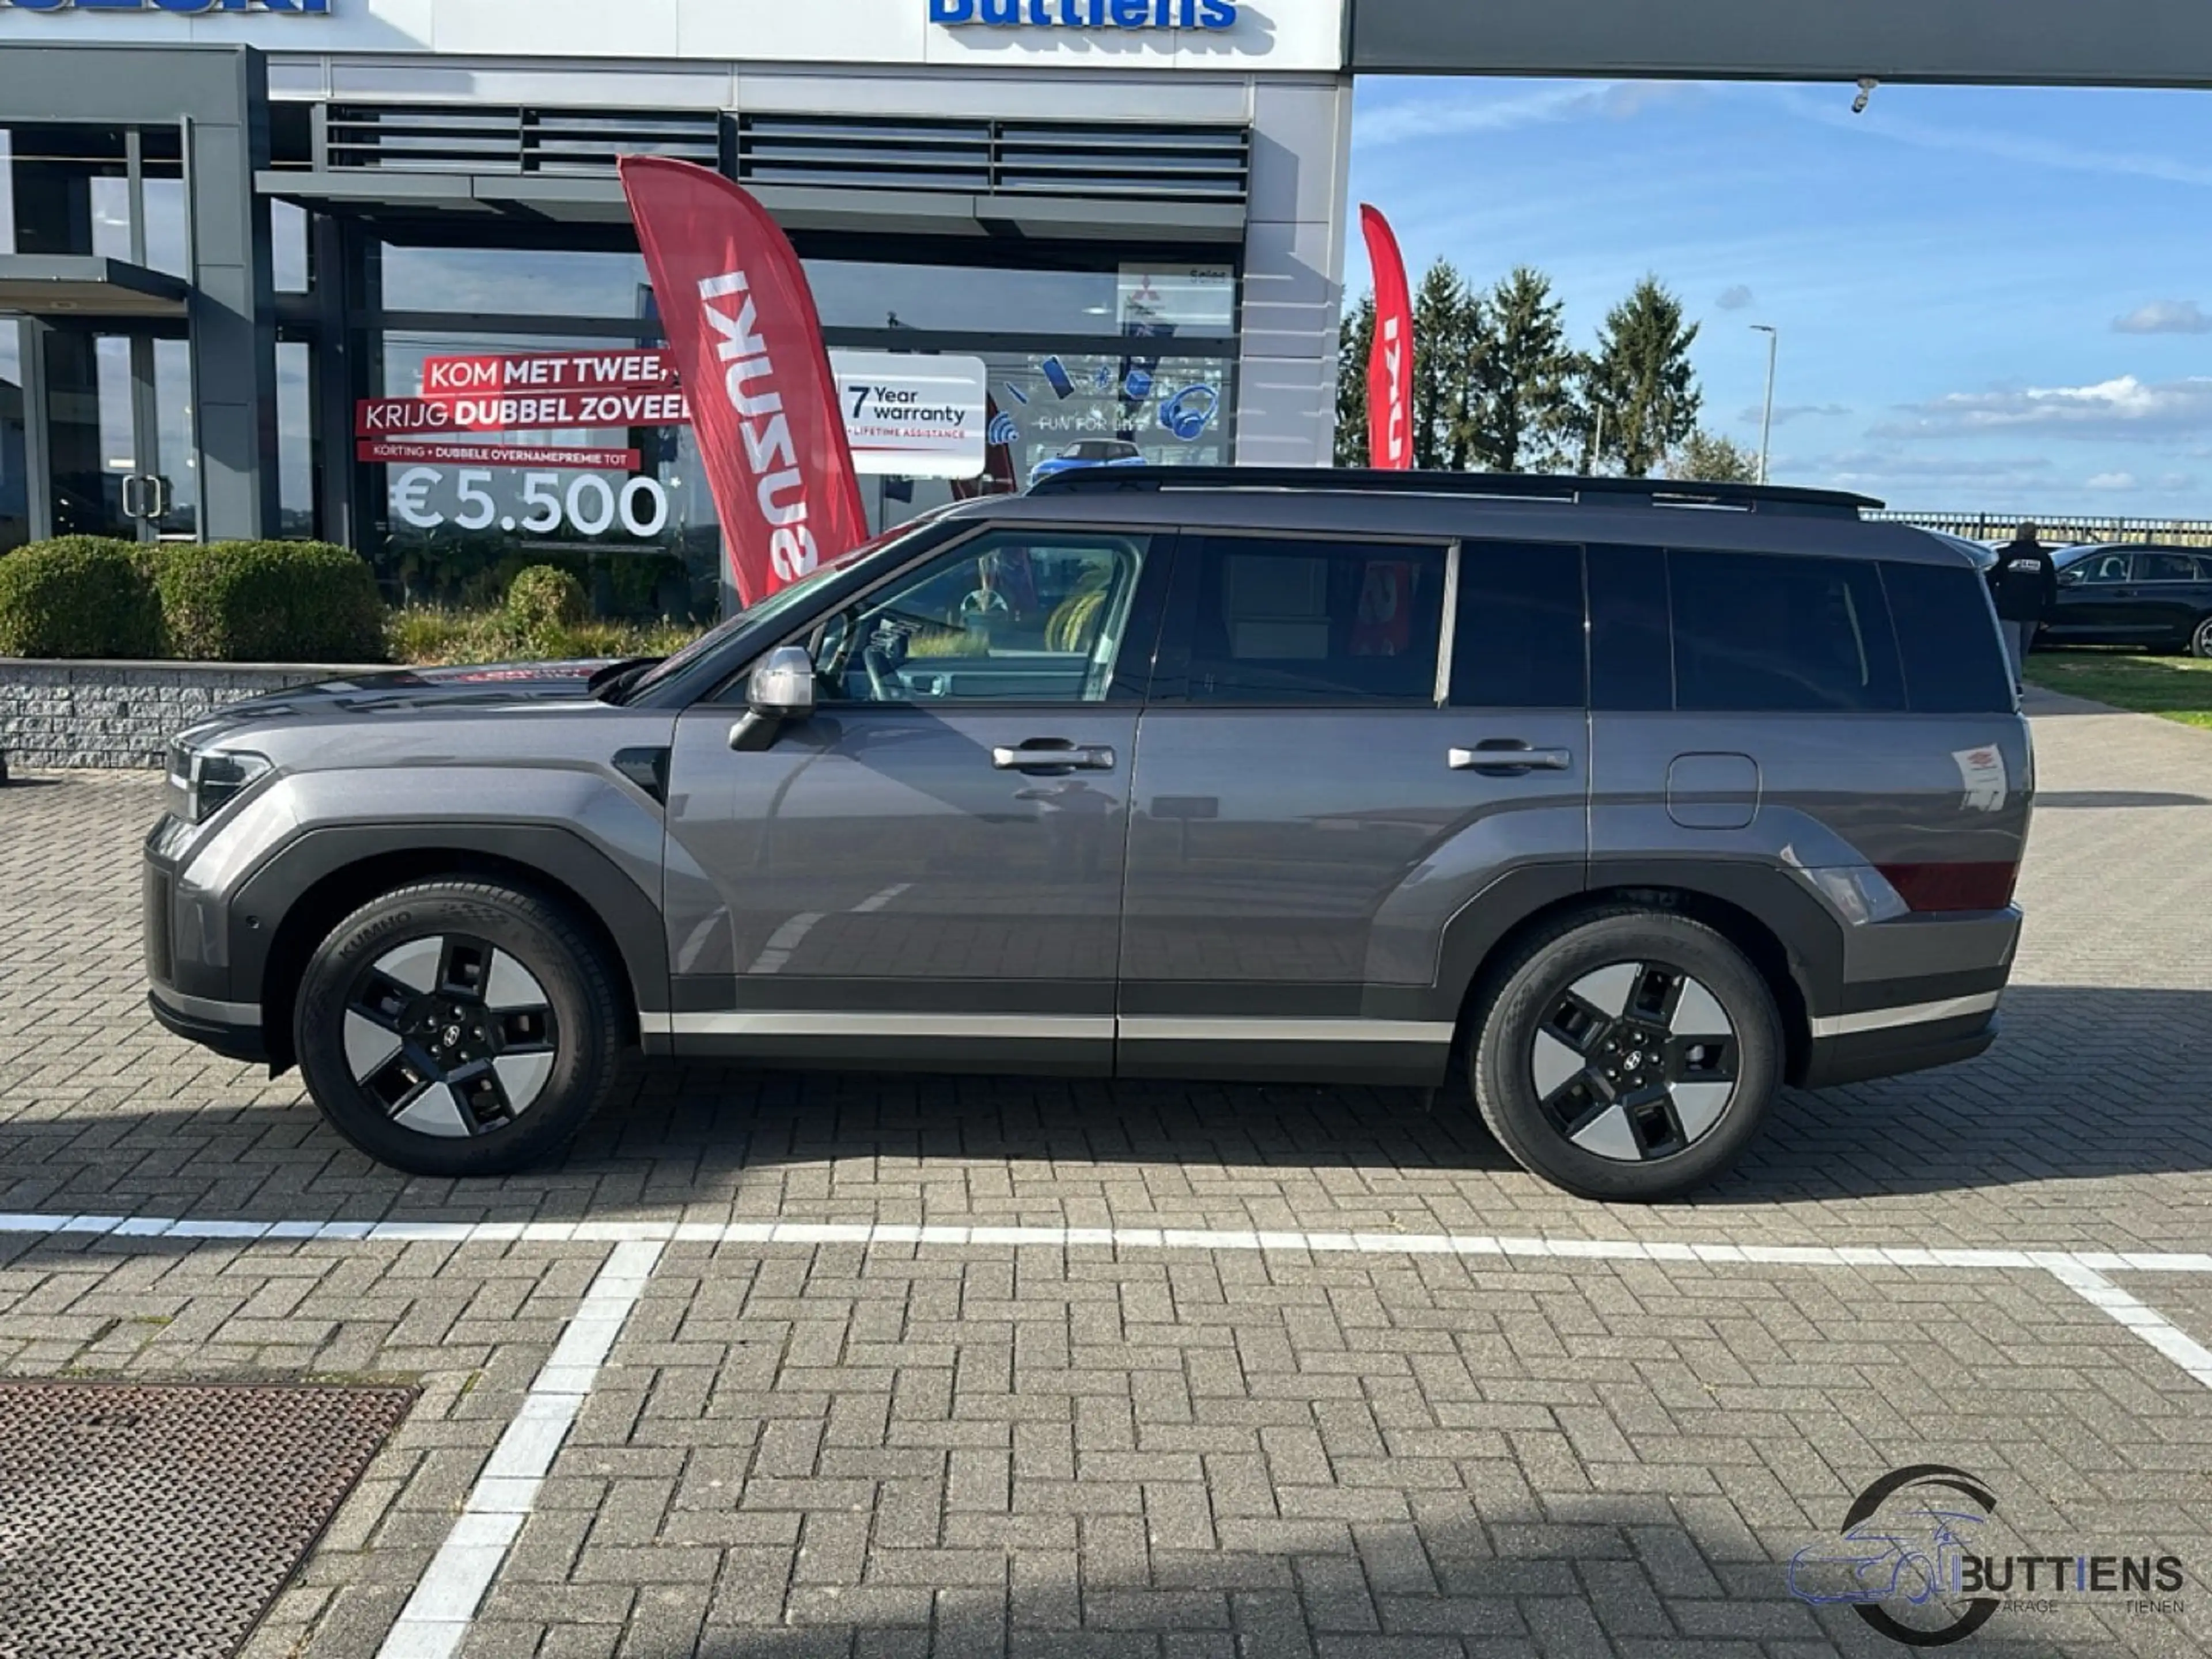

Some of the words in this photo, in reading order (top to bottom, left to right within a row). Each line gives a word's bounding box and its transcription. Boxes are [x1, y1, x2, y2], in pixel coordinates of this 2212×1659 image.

[431, 361, 498, 388] KOM
[503, 358, 568, 384] MET
[573, 355, 668, 382] TWEE,
[366, 402, 448, 429] KRIJG
[454, 398, 573, 425] DUBBEL
[578, 394, 691, 421] ZOVEEL
[848, 385, 870, 419] 7
[874, 385, 918, 403] Year
[873, 406, 965, 426] warranty
[854, 427, 900, 437] LIFETIME
[903, 428, 965, 439] ASSISTANCE
[373, 446, 425, 457] KORTING
[435, 447, 489, 460] DUBBELE
[491, 449, 602, 463] OVERNAMEPREMIE
[604, 454, 627, 465] TOT
